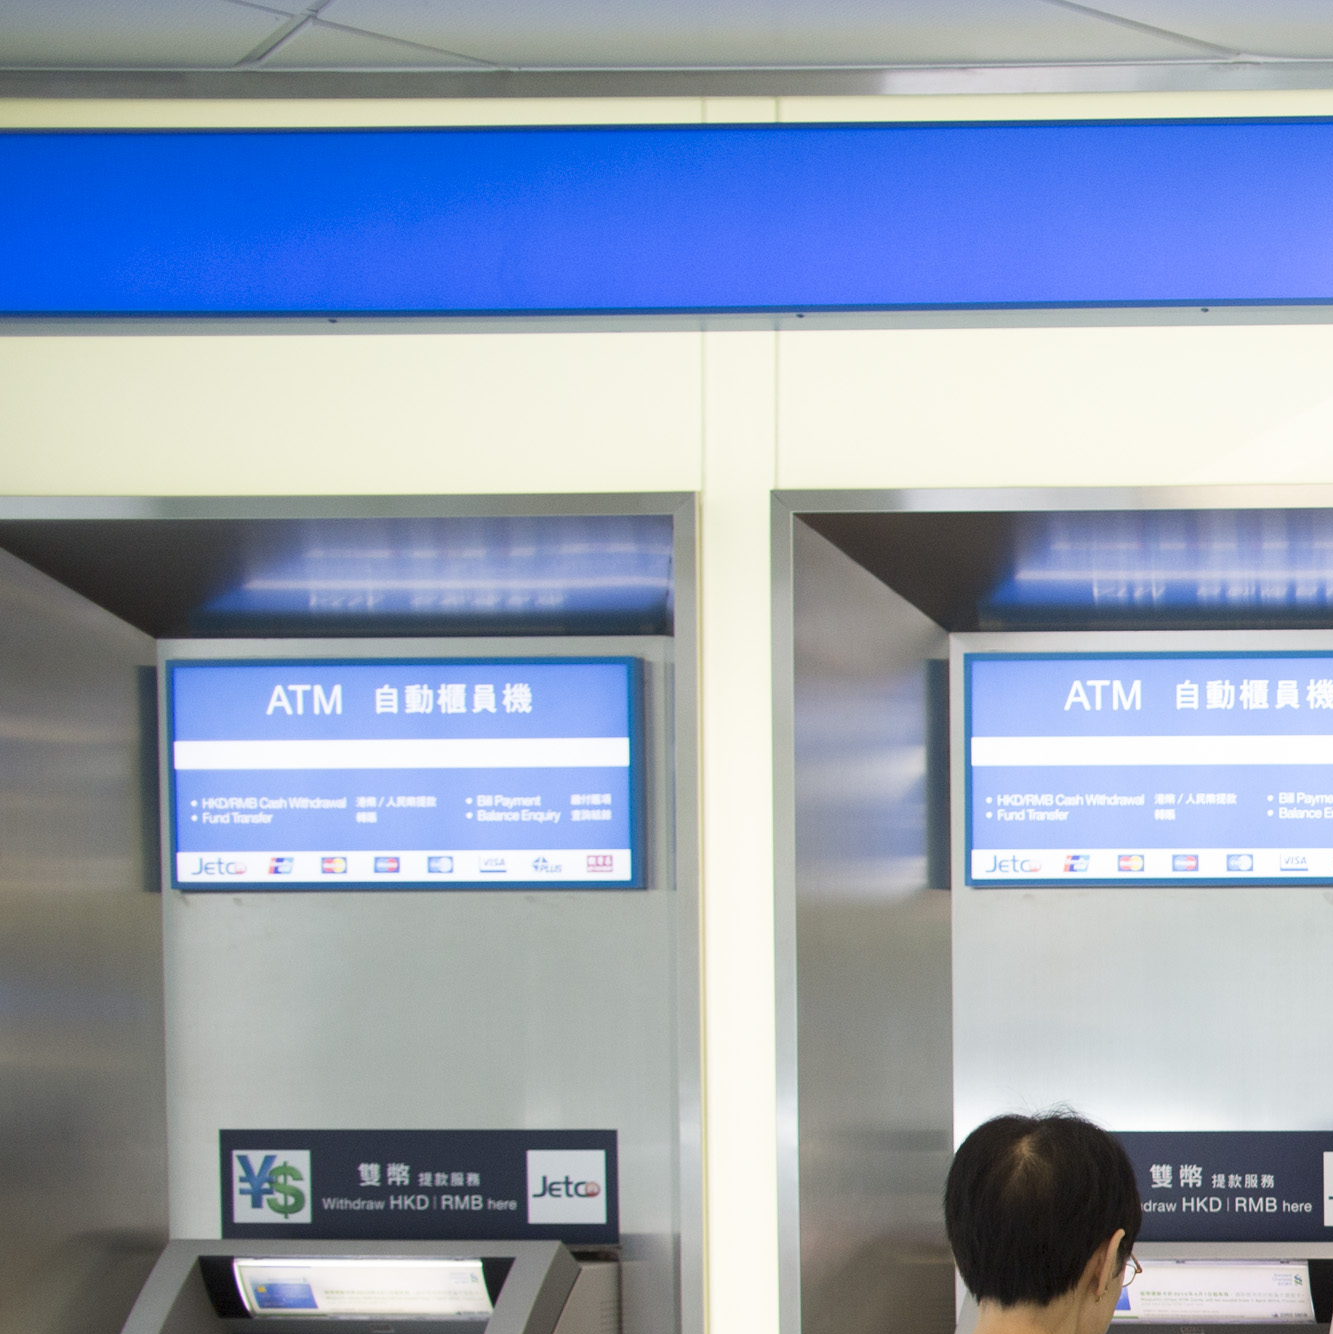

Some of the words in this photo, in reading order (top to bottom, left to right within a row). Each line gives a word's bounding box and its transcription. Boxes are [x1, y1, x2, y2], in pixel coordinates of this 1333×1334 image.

[266, 683, 343, 716] ATM
[374, 683, 533, 716] 自動櫃員機
[1063, 679, 1142, 711] ATM
[997, 793, 1054, 806] HKD/RMB
[1055, 793, 1084, 806] Cash
[1085, 793, 1145, 806] Withdrawal
[1278, 791, 1295, 804] Bill
[997, 808, 1025, 821] Fund
[1027, 808, 1070, 821] Transfer
[1278, 806, 1322, 819] Balance
[322, 1196, 386, 1211] Withdraw
[389, 1195, 430, 1211] HKD
[441, 1195, 484, 1211] RMB
[487, 1197, 518, 1211] here
[1181, 1197, 1222, 1213] HKD
[1234, 1197, 1278, 1213] RMB
[1282, 1199, 1313, 1213] here
